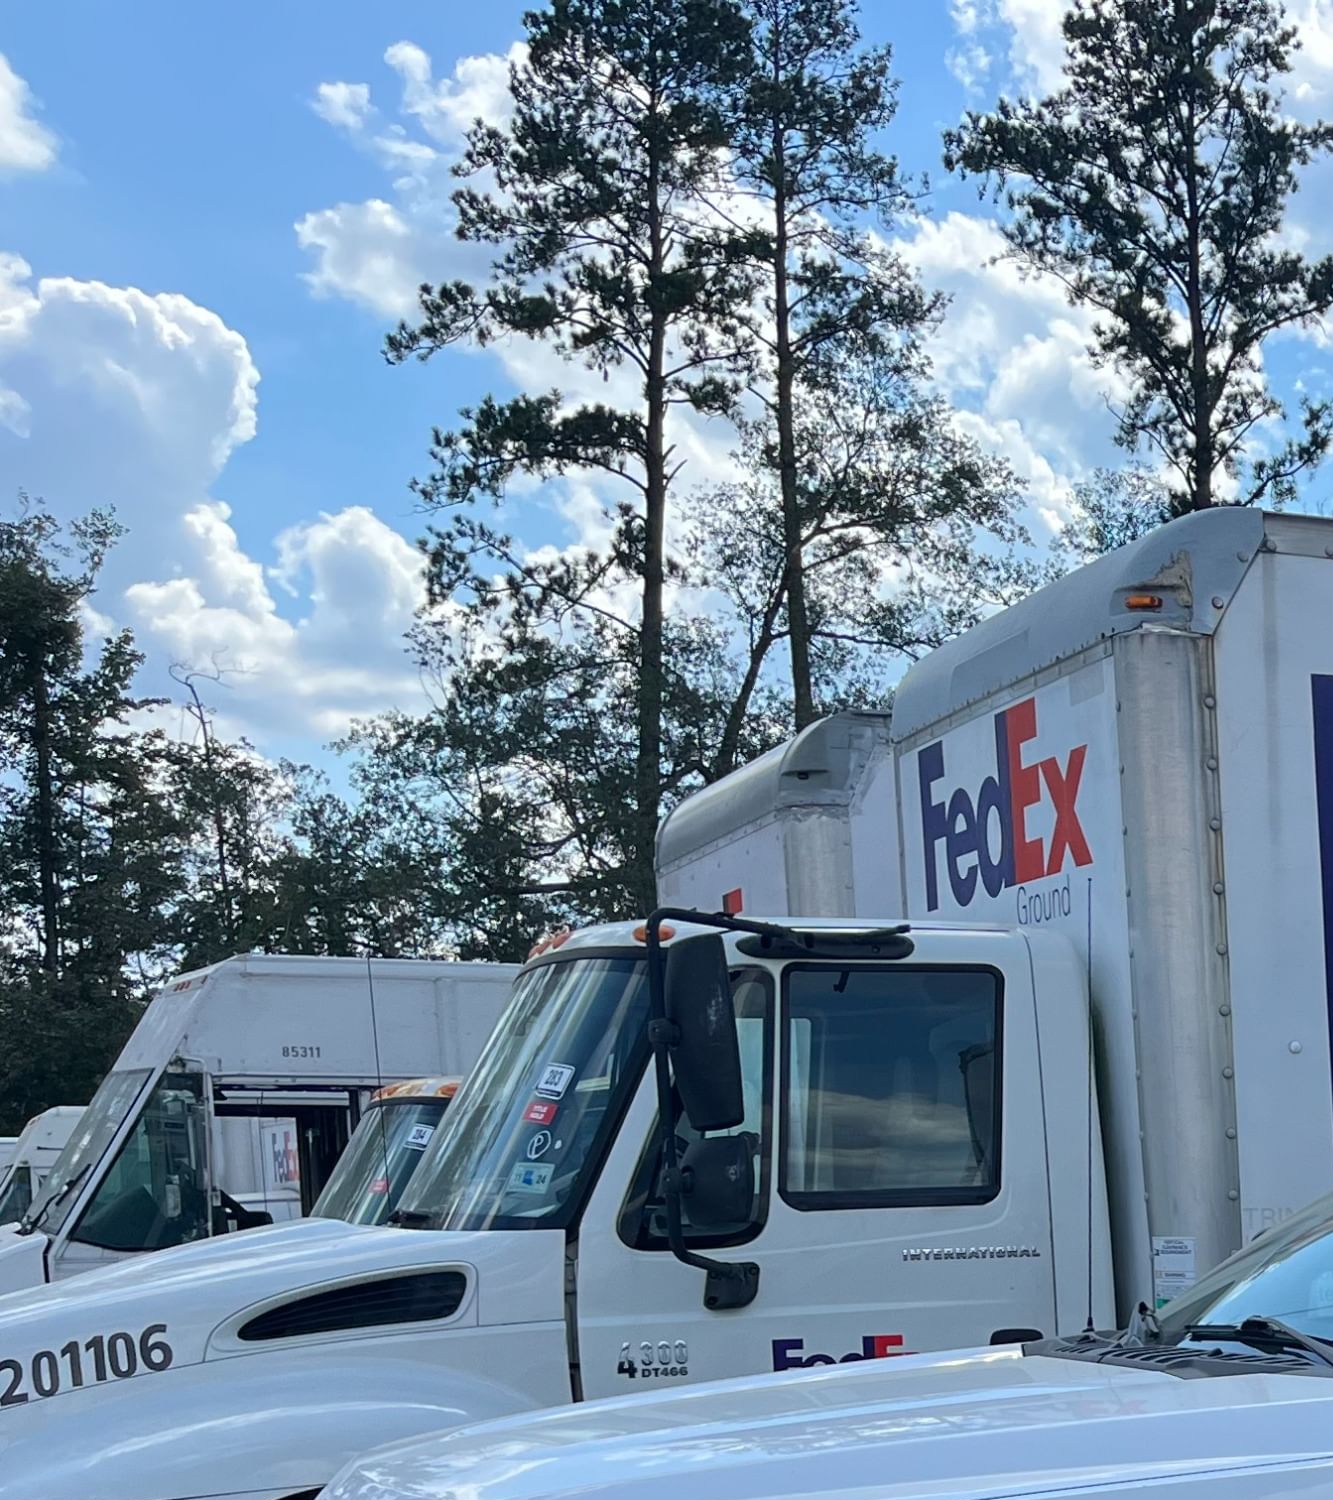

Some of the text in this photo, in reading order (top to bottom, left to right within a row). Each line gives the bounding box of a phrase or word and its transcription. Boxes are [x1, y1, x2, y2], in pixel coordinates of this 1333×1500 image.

[918, 697, 1093, 912] FedEx
[1016, 874, 1071, 925] Ground
[281, 1046, 321, 1058] 85311
[902, 1245, 1041, 1262] INTERNATIONAL
[0, 1324, 173, 1406] 201106
[641, 1366, 689, 1378] DT466
